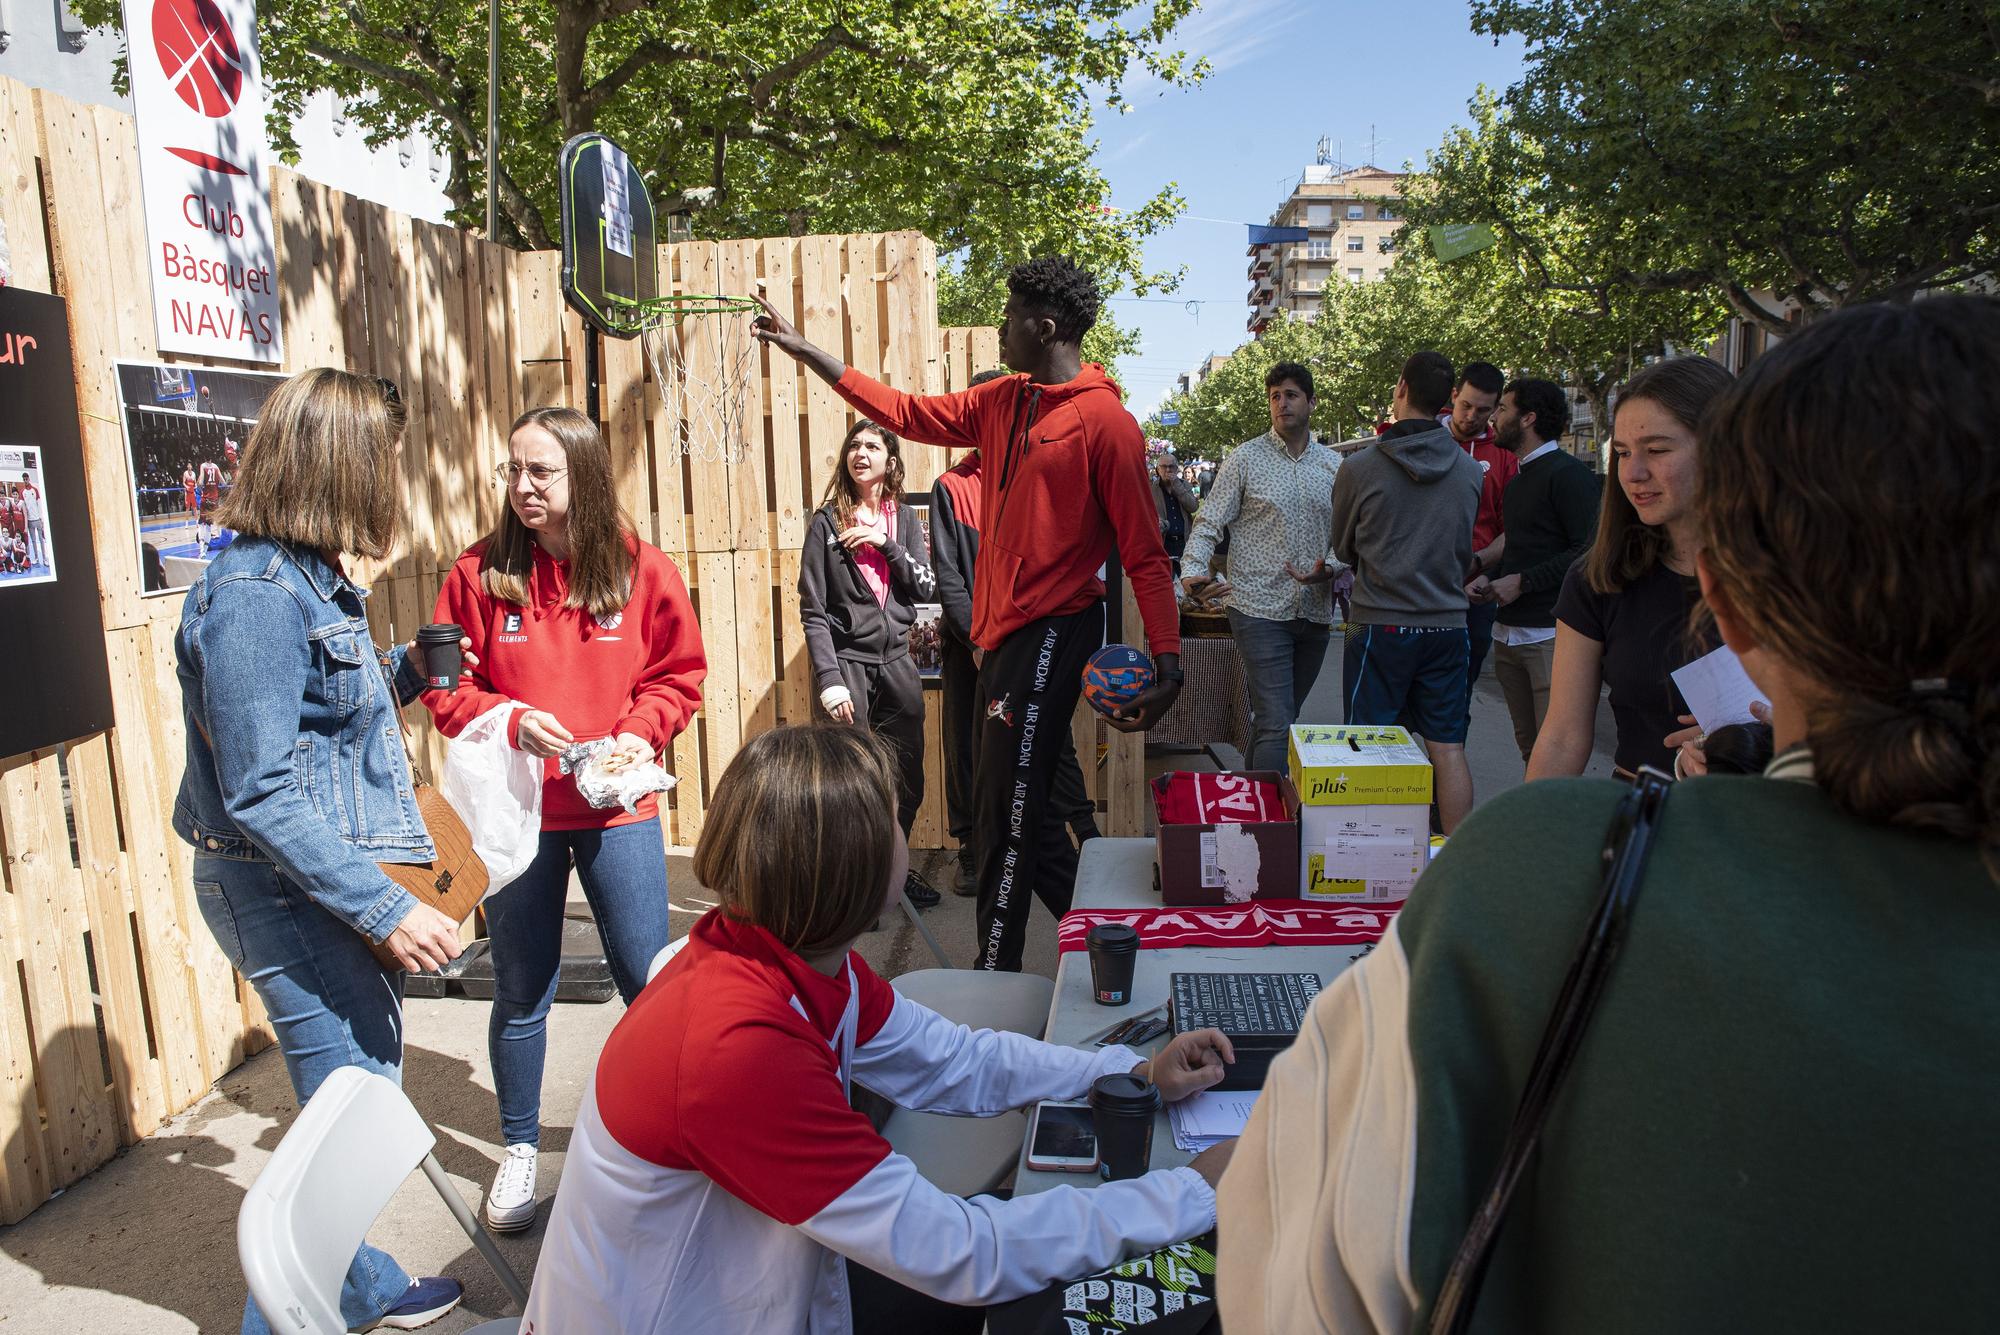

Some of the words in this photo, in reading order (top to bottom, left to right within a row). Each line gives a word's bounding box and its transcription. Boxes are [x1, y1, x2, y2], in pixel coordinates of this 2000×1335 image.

[183, 194, 243, 238] Club
[163, 242, 271, 296] Bàsquet
[171, 299, 272, 345] NAVÀS
[498, 635, 529, 643] ELEMENTS
[1043, 627, 1058, 649] AIR
[1033, 647, 1051, 692] JORDAN
[1026, 703, 1040, 724] AIR
[1018, 722, 1036, 767] JORDAN
[1014, 780, 1027, 799] AIR
[1311, 778, 1347, 799] plus
[1354, 786, 1384, 794] Premium
[1387, 787, 1405, 796] Copy
[1408, 786, 1427, 794] Paper
[1004, 847, 1018, 868] AIR
[997, 866, 1014, 909] JORDAN
[989, 918, 1004, 940] AIR
[1206, 1012, 1219, 1029] LOV
[1220, 1012, 1234, 1031] LIVE
[1233, 1012, 1248, 1031] LAUGH
[1165, 1254, 1202, 1288] la
[1062, 1280, 1211, 1325] PRI
